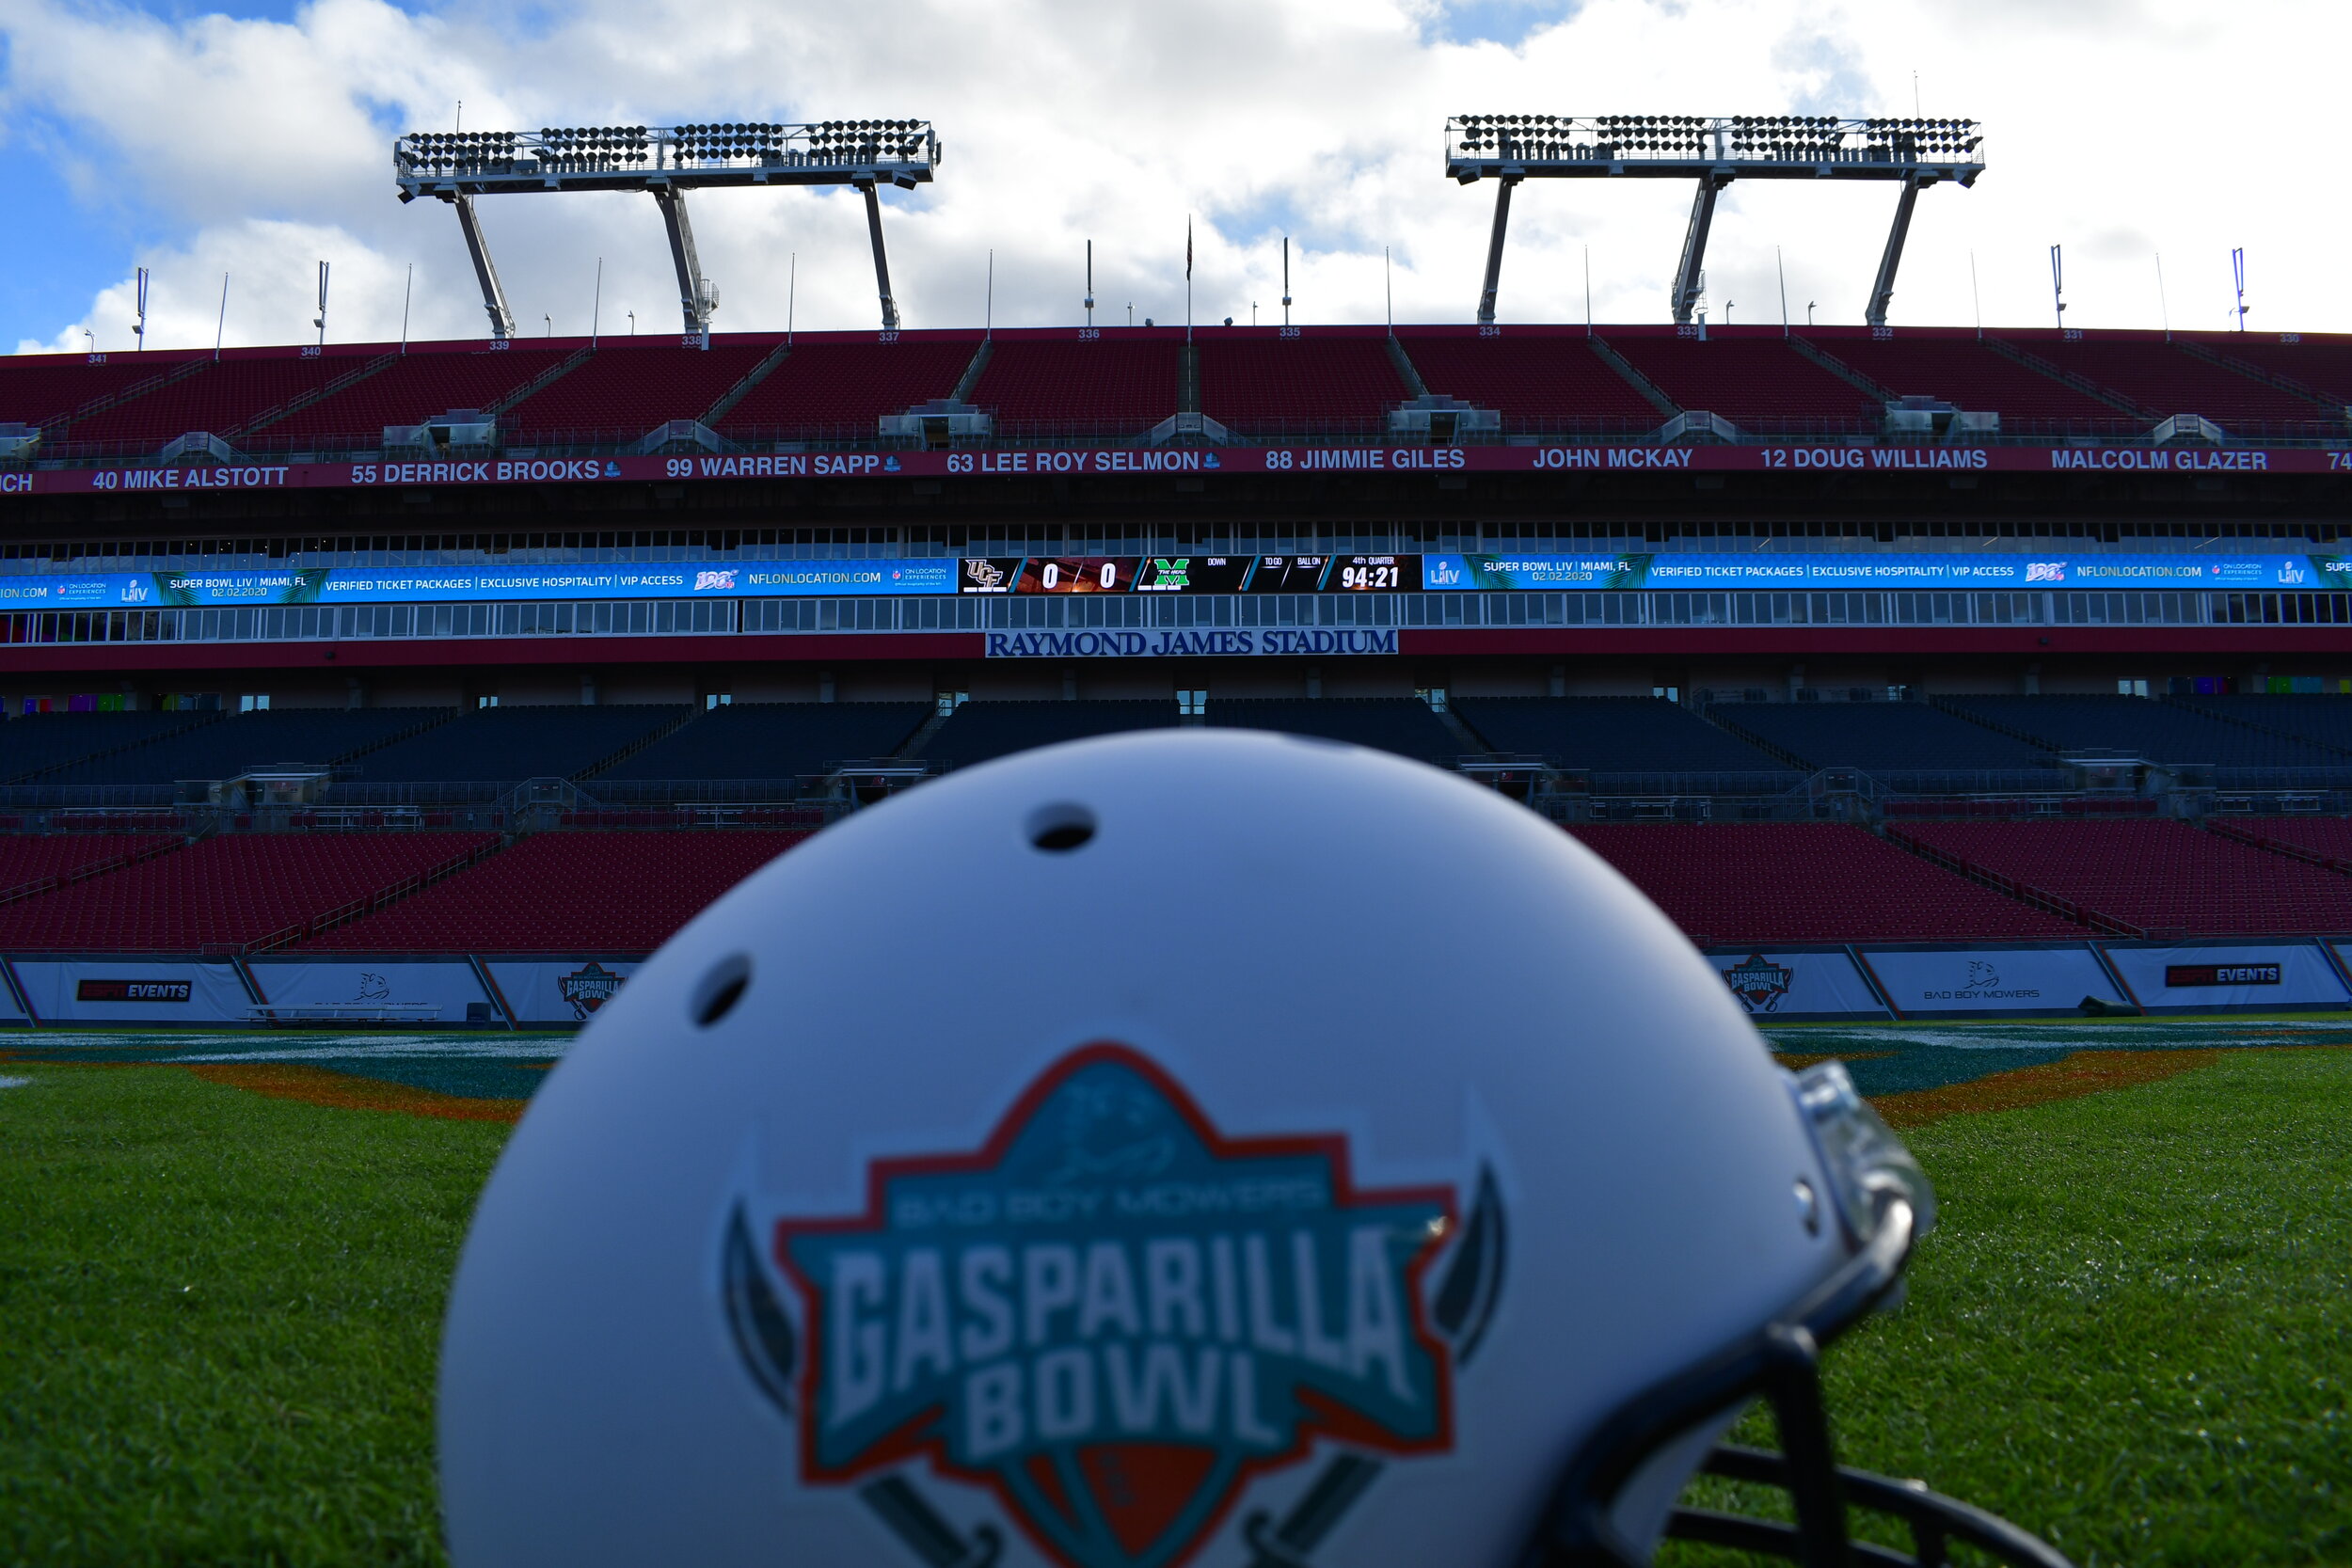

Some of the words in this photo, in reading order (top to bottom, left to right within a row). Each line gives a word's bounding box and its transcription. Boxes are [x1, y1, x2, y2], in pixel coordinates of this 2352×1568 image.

[1078, 328, 1100, 339] 336
[1279, 326, 1301, 337] 335
[1479, 325, 1501, 336] 334
[1677, 325, 1698, 336] 333
[1872, 326, 1894, 337] 332
[2064, 329, 2083, 340] 331
[681, 335, 701, 346] 338
[879, 332, 899, 342] 337
[301, 346, 322, 356] 340
[489, 340, 510, 351] 339
[88, 354, 107, 364] 341
[946, 453, 974, 472] 63
[981, 452, 1028, 471] LEE
[1036, 451, 1088, 471] ROY
[1094, 451, 1200, 471] SELMON
[1265, 450, 1293, 469] 88
[1299, 449, 1385, 469] JIMMIE
[1391, 449, 1465, 468] GILES
[1533, 448, 1600, 468] JOHN
[1608, 448, 1693, 468] MCKAY
[1761, 449, 1788, 467] 12
[1794, 448, 1866, 468] DOUG
[1871, 449, 1988, 469] WILLIAMS
[2051, 450, 2169, 469] MALCOLM
[2174, 451, 2267, 470] GLAZER
[2327, 451, 2352, 470] 74
[351, 466, 377, 483] 55
[384, 462, 490, 483] DERRICK
[497, 459, 600, 481] BROOKS
[666, 458, 693, 477] 99
[700, 455, 806, 476] WARREN
[814, 454, 880, 474] SAPP
[93, 471, 119, 490] 40
[124, 469, 180, 489] MIKE
[184, 467, 289, 487] ALSTOTT
[1369, 556, 1394, 564] QUARTER
[1484, 562, 1519, 572] SUPER
[1522, 562, 1553, 571] BOWL
[1556, 562, 1572, 571] LIV
[1581, 562, 1615, 572] MIAMI,
[1618, 562, 1631, 571] FL
[1651, 566, 1702, 577] VERIFIED
[1705, 566, 1743, 577] TICKET
[1746, 566, 1804, 577] PACKAGES
[1813, 566, 1871, 577] EXCLUSIVE
[1875, 566, 1945, 577] HOSPITALITY
[1951, 566, 1970, 577] VIP
[1972, 566, 2014, 576] ACCESS
[2077, 566, 2201, 578] NFLONLOCATION.COM
[749, 573, 881, 584] NFLONLOCATION.COM
[966, 560, 1003, 588] UCF
[1042, 563, 1058, 589] 0
[1100, 562, 1116, 589] 0
[1343, 567, 1398, 588] 94:21
[1533, 572, 1593, 581] 02.02.2020
[170, 579, 202, 589] SUPER
[206, 578, 232, 588] BOWL
[237, 578, 252, 588] LIV
[260, 578, 293, 588] MIAMI,
[294, 577, 307, 586] FL
[326, 581, 373, 591] VERIFIED
[376, 580, 413, 590] TICKET
[416, 579, 471, 589] PACKAGES
[481, 578, 539, 588] EXCLUSIVE
[543, 577, 612, 587] HOSPITALITY
[620, 576, 639, 585] VIP
[641, 576, 683, 585] ACCESS
[212, 588, 267, 597] 02.02.2020
[988, 632, 1147, 657] RAYMOND
[1152, 631, 1253, 656] JAMES
[1263, 629, 1396, 655] STADIUM
[1731, 972, 1786, 989] GASPARILLA
[2217, 967, 2277, 982] EVENTS
[128, 984, 188, 998] EVENTS
[1744, 981, 1772, 991] BOWL
[579, 990, 607, 1000] BOWL
[1924, 990, 1951, 999] BAD
[1955, 990, 1980, 999] BOY
[1983, 990, 2040, 998] MOWERS
[1005, 1186, 1104, 1221] BOY
[1117, 1176, 1324, 1218] MOWERS
[826, 1226, 1421, 1430] GASPARILLA
[966, 1343, 1280, 1463] BOWL
